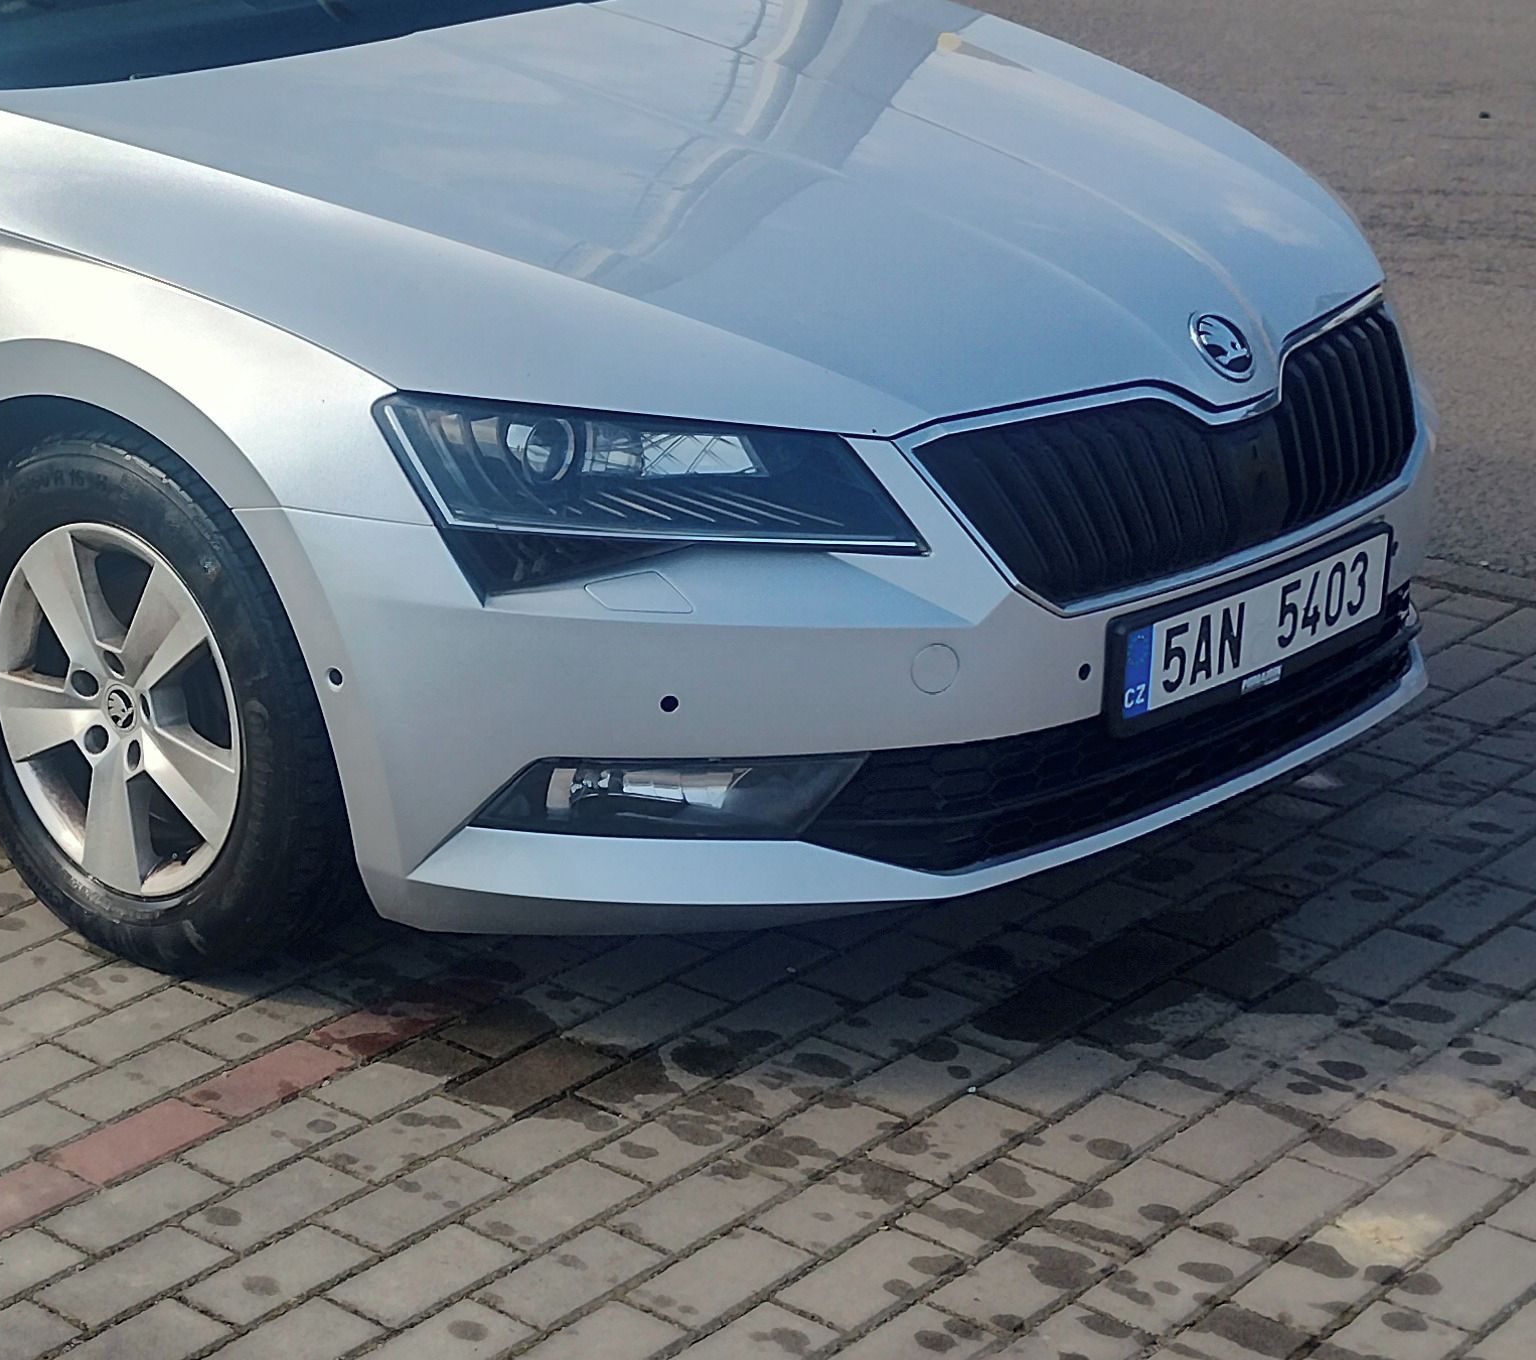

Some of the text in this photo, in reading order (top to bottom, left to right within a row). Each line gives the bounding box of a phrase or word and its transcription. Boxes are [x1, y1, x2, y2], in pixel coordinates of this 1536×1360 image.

[1161, 551, 1369, 694] 5AN 5403
[1123, 683, 1146, 709] CZ
